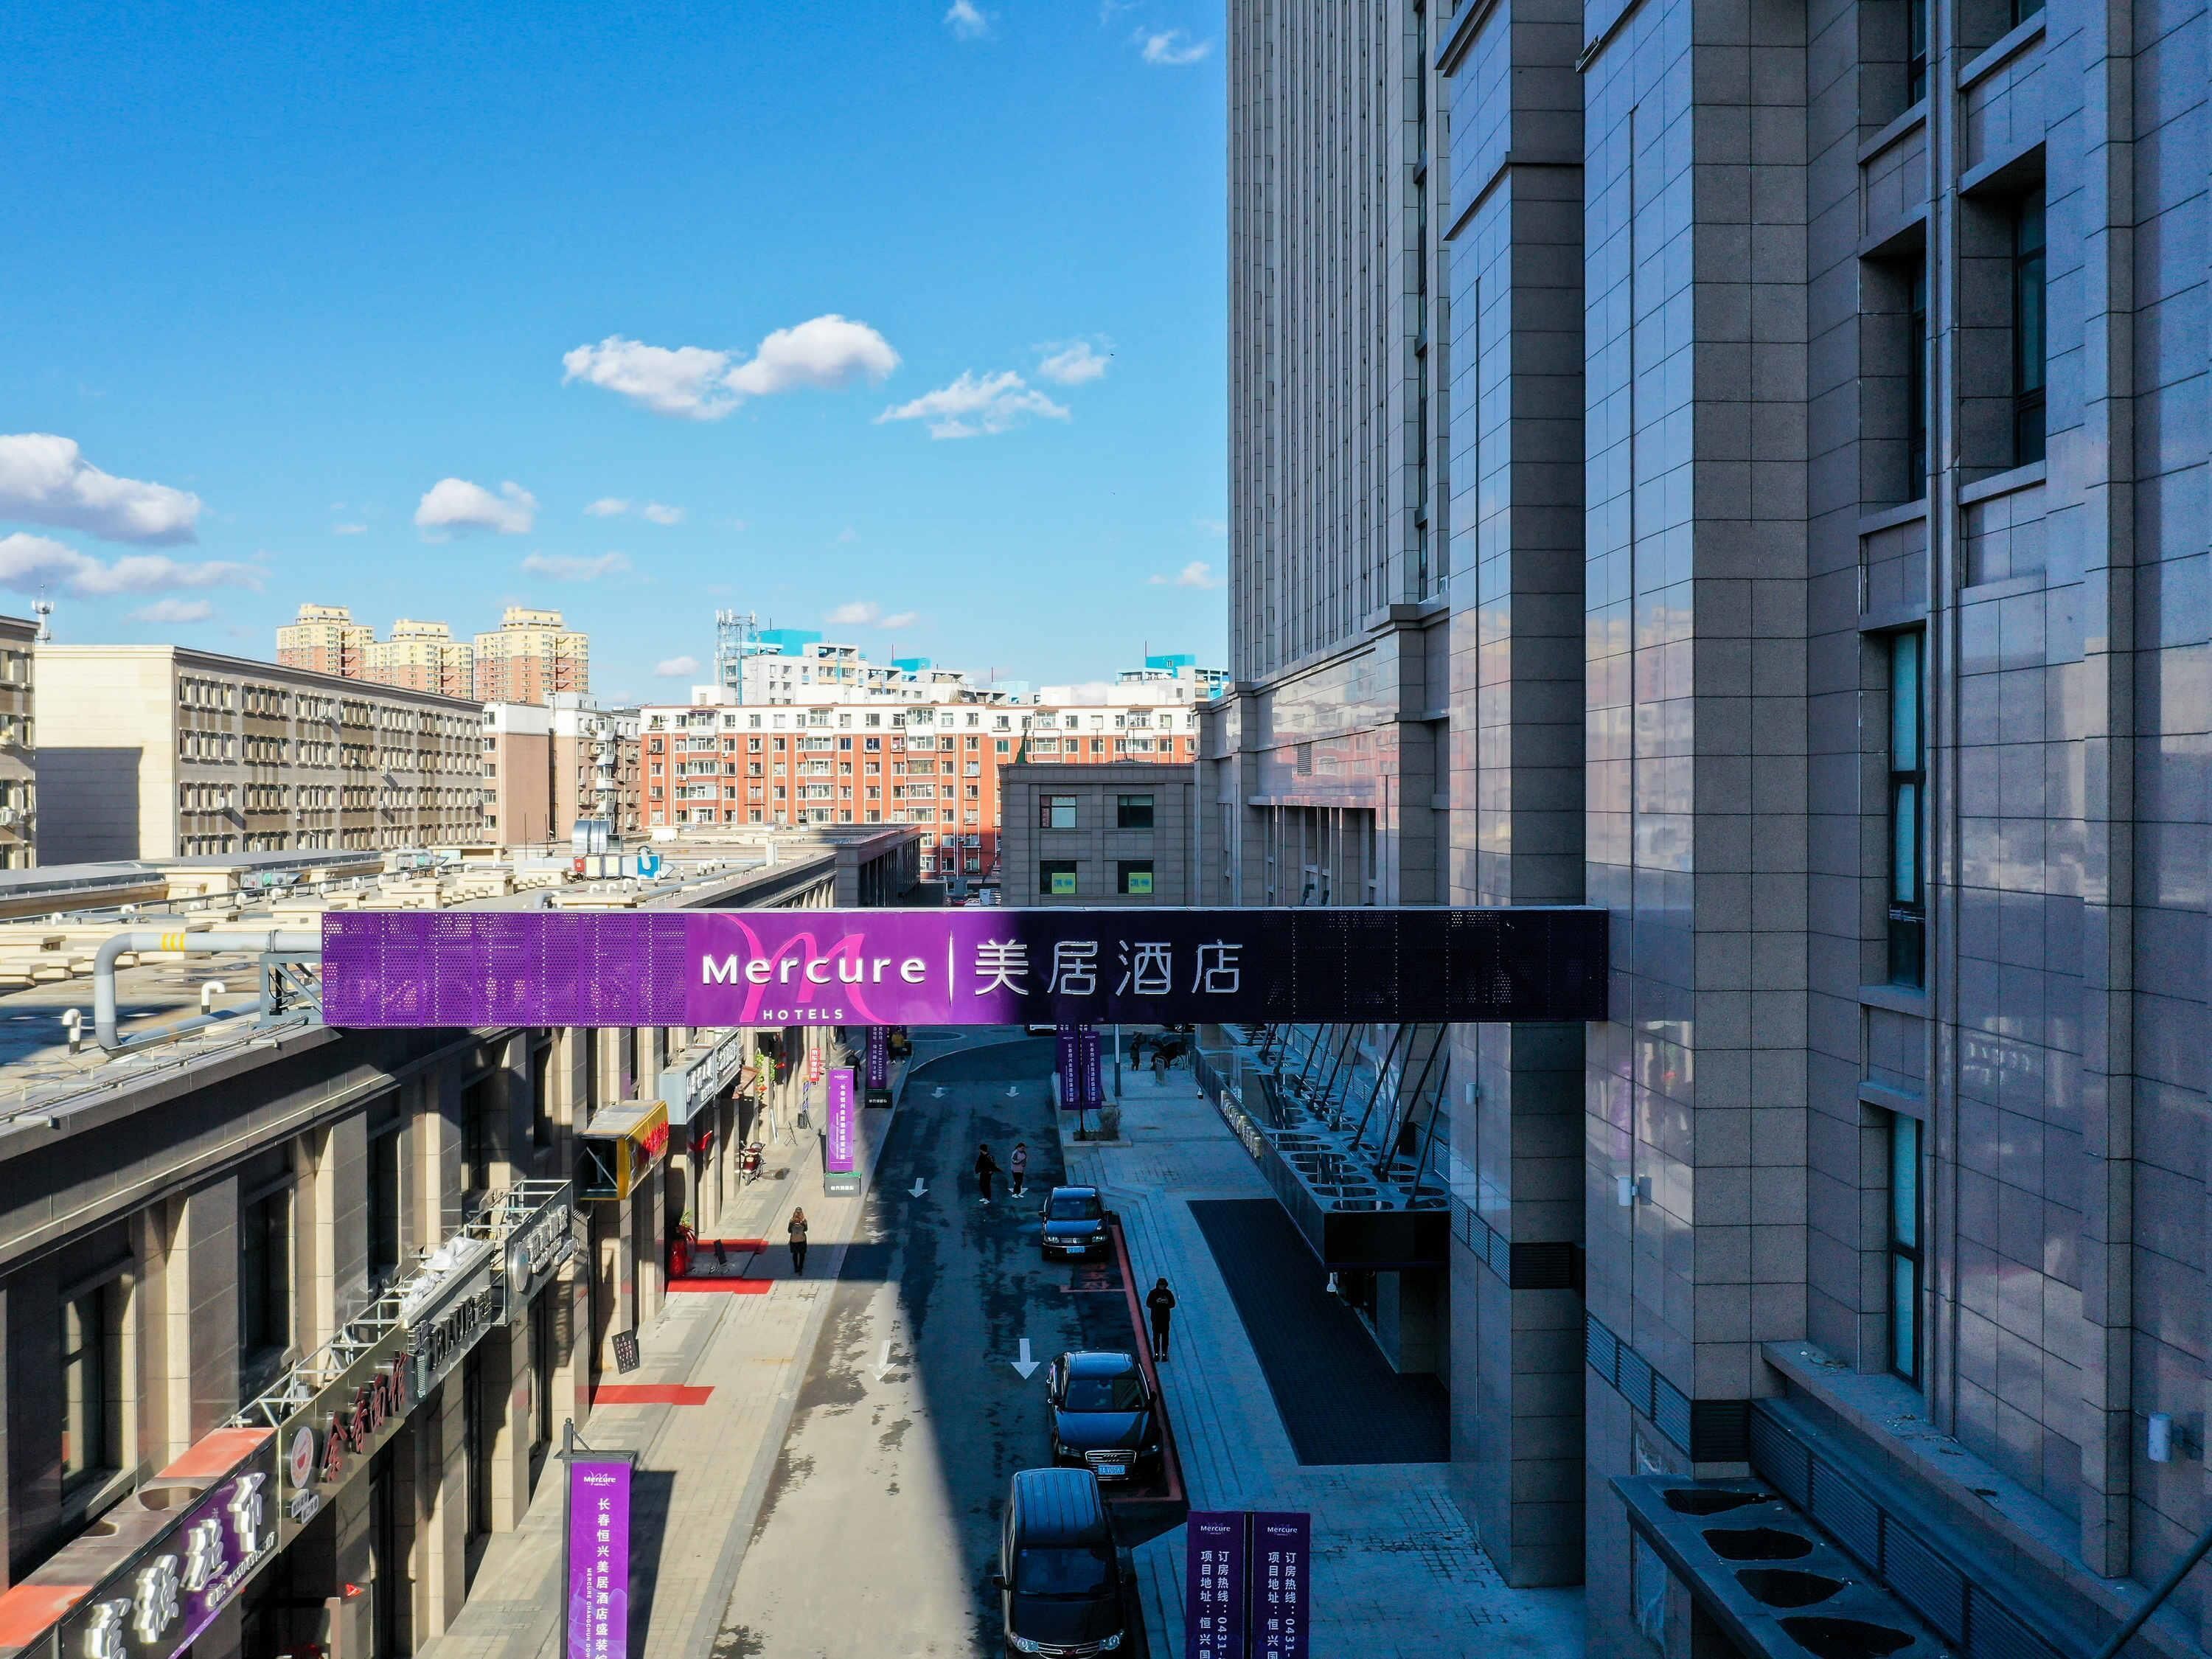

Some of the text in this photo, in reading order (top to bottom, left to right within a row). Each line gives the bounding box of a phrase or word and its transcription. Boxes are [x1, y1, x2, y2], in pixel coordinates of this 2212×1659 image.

[702, 954, 927, 985] Mercure
[974, 938, 1244, 996] 美居酒店
[762, 1009, 844, 1020] HOTELS
[1217, 1551, 1230, 1659] 订房热线：0431-
